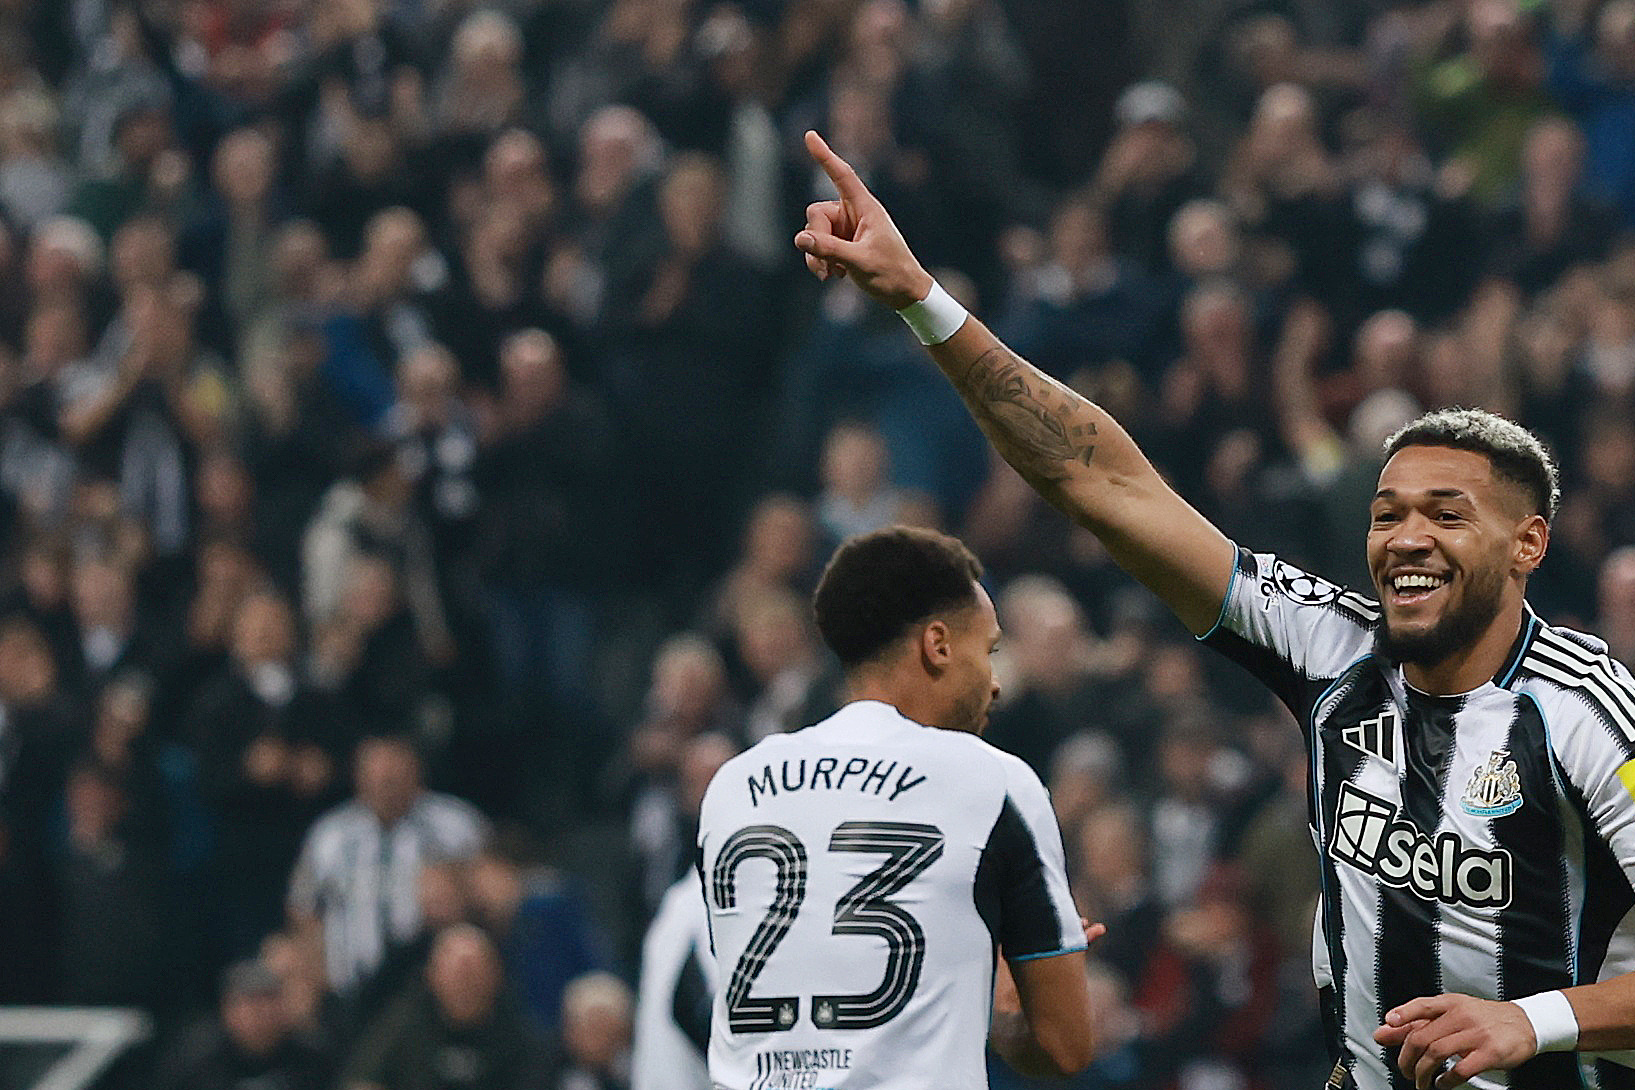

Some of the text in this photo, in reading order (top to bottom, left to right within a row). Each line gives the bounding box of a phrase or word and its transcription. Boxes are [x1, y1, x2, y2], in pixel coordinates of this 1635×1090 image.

[747, 757, 926, 807] MURPHY
[1379, 829, 1503, 901] sela
[713, 822, 945, 1034] 23
[773, 1049, 853, 1070] NEWCASTLE
